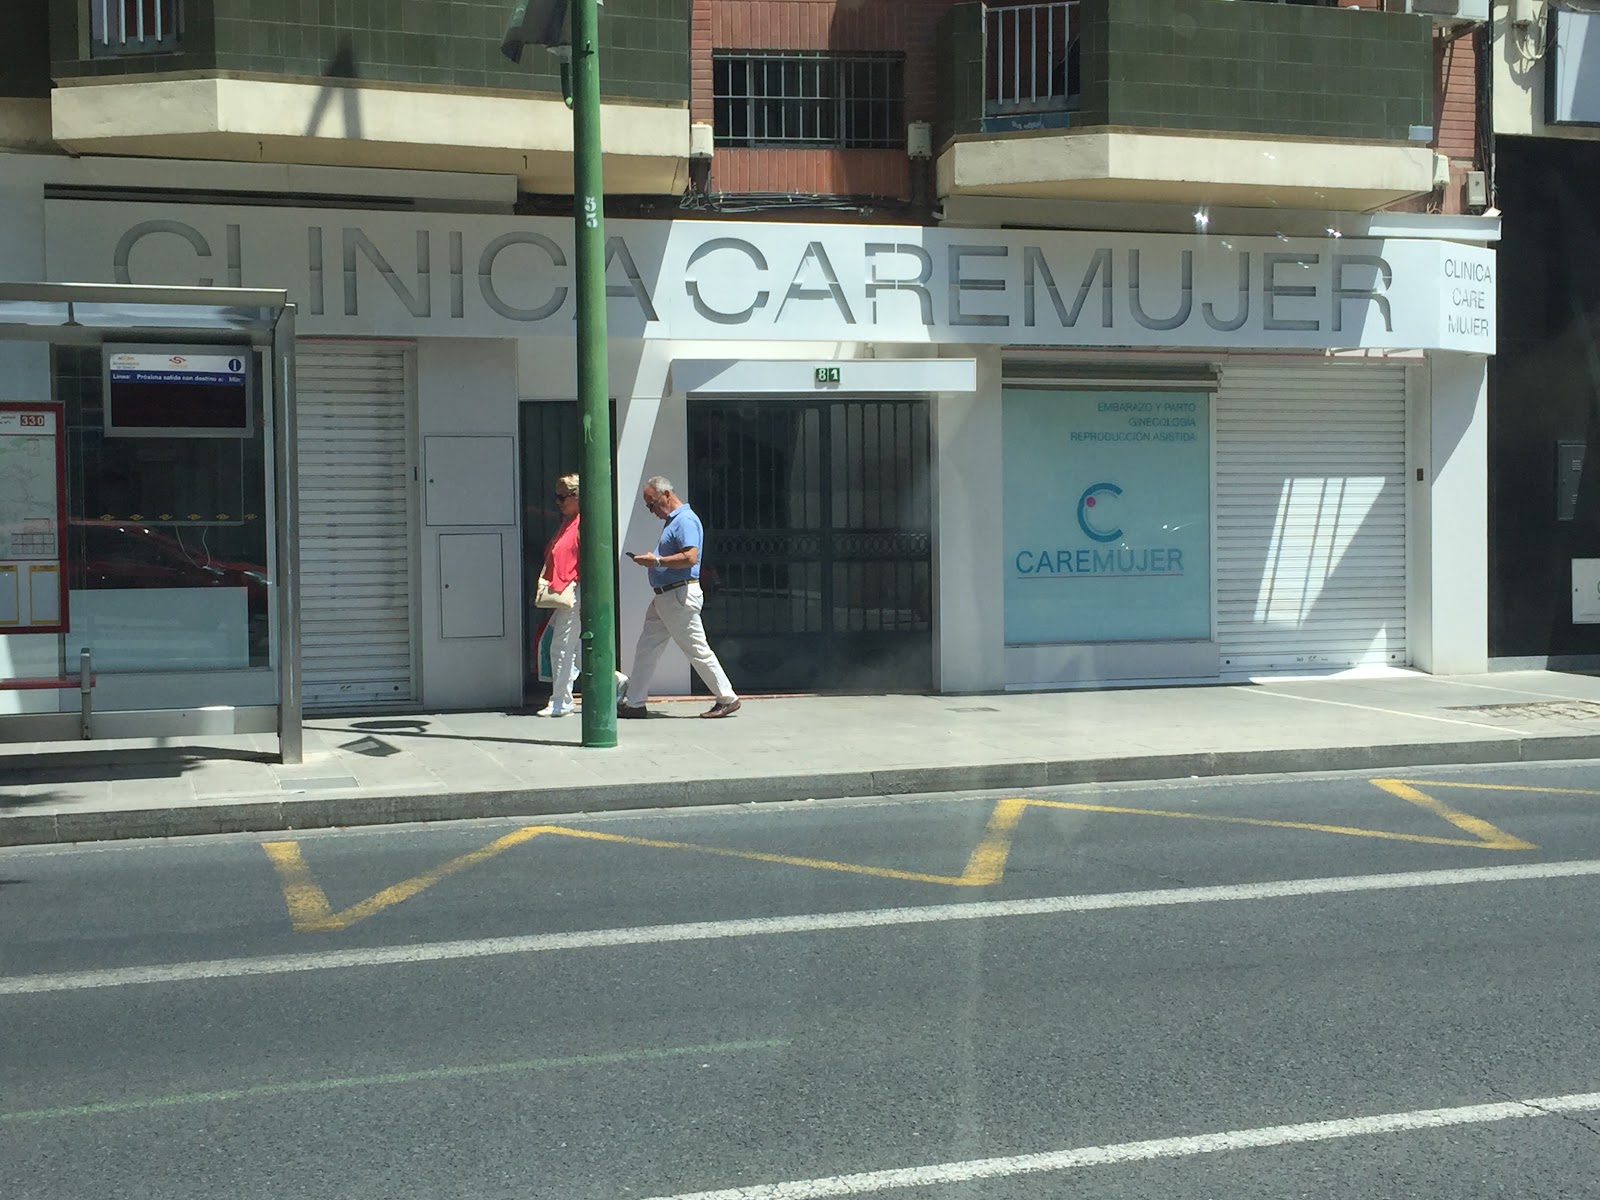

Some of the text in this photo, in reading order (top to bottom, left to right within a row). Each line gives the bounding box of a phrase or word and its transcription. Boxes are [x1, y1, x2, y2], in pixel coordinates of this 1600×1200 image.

[1444, 259, 1492, 283] CLINICA
[1452, 288, 1485, 309] CARE
[1448, 314, 1489, 337] MUJER
[818, 368, 839, 381] 81
[1097, 402, 1196, 413] EMBARAZO Y PARTO
[21, 415, 44, 426] 330
[1152, 431, 1196, 442] ASISTIDA
[1015, 549, 1185, 573] CAREMUJER
